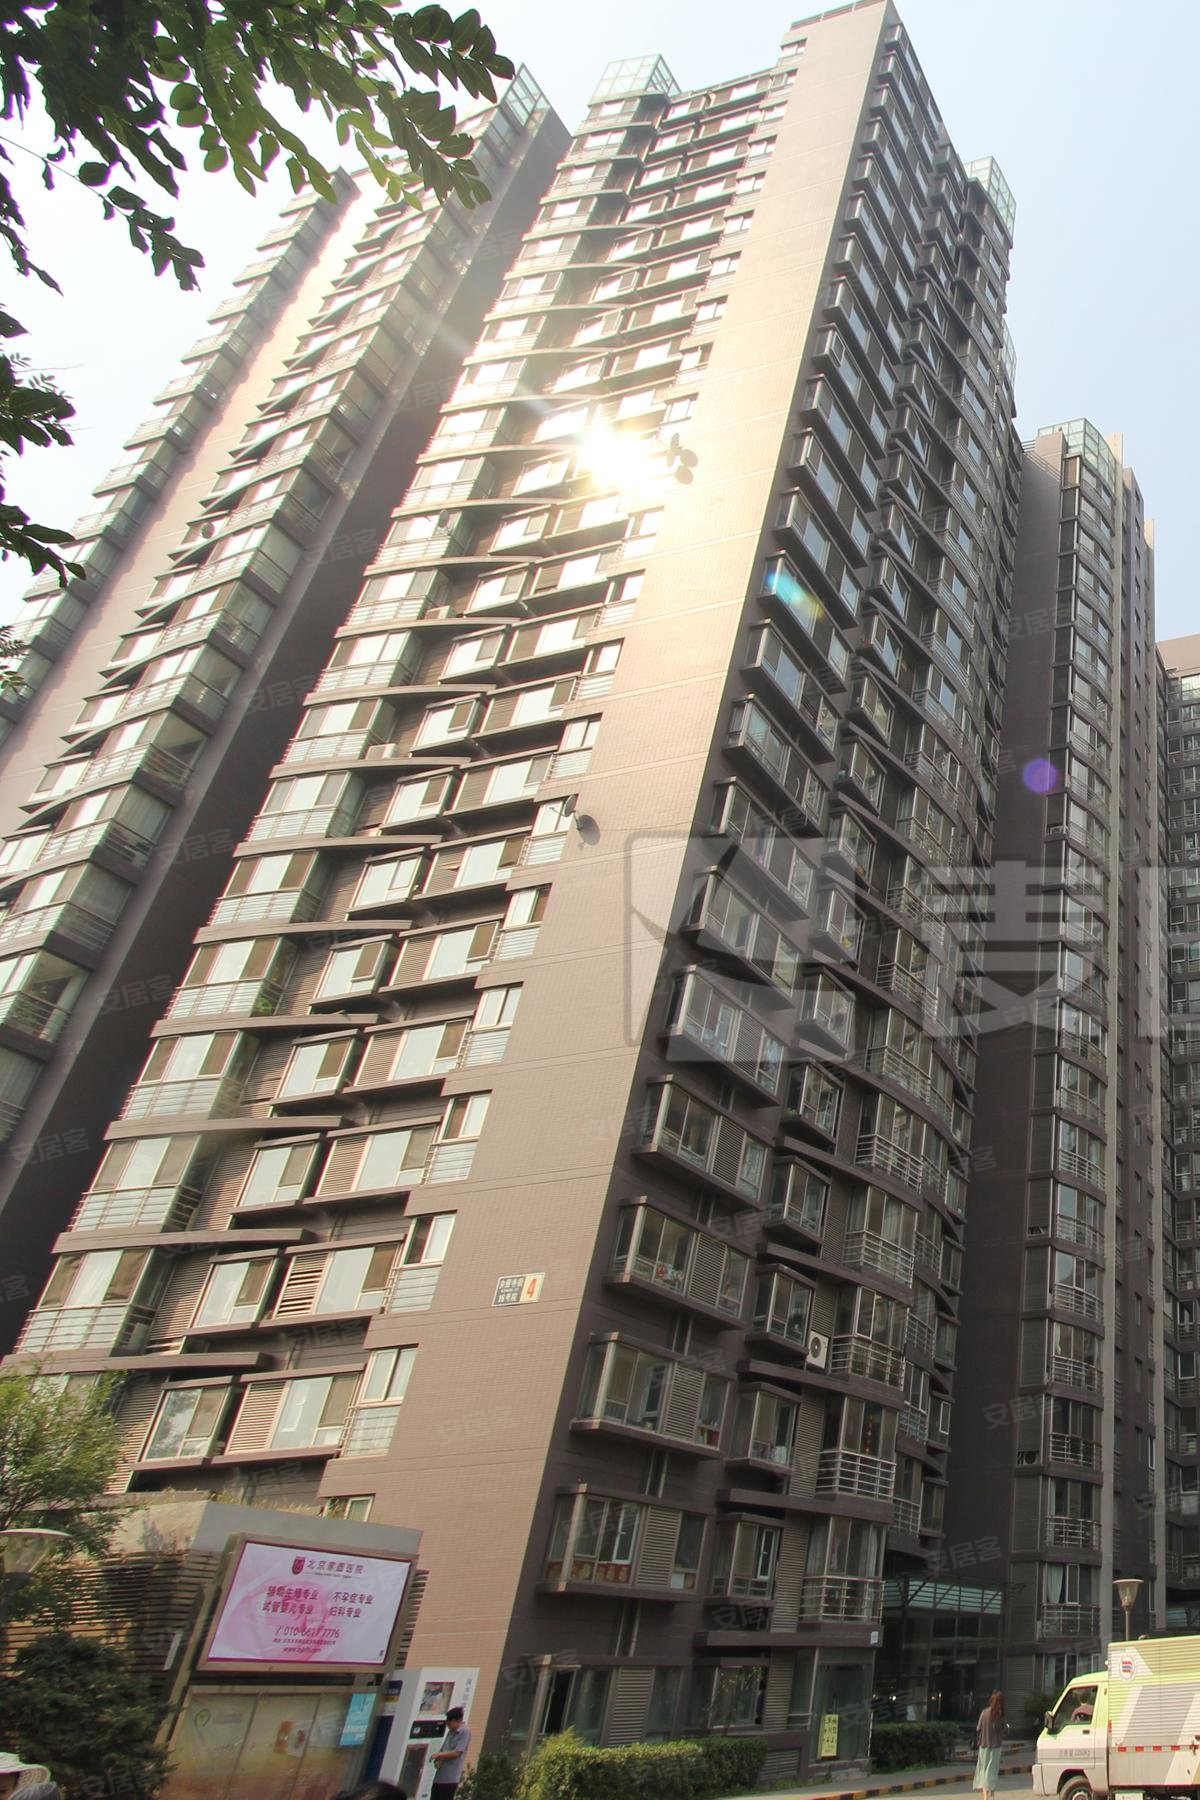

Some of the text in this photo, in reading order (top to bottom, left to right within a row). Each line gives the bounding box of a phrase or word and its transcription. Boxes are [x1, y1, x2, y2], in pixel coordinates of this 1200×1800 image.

[527, 1278, 537, 1298] 4
[332, 1591, 375, 1605] 不孕症专业
[262, 1600, 363, 1618] 试管婴儿专业 妇科专业
